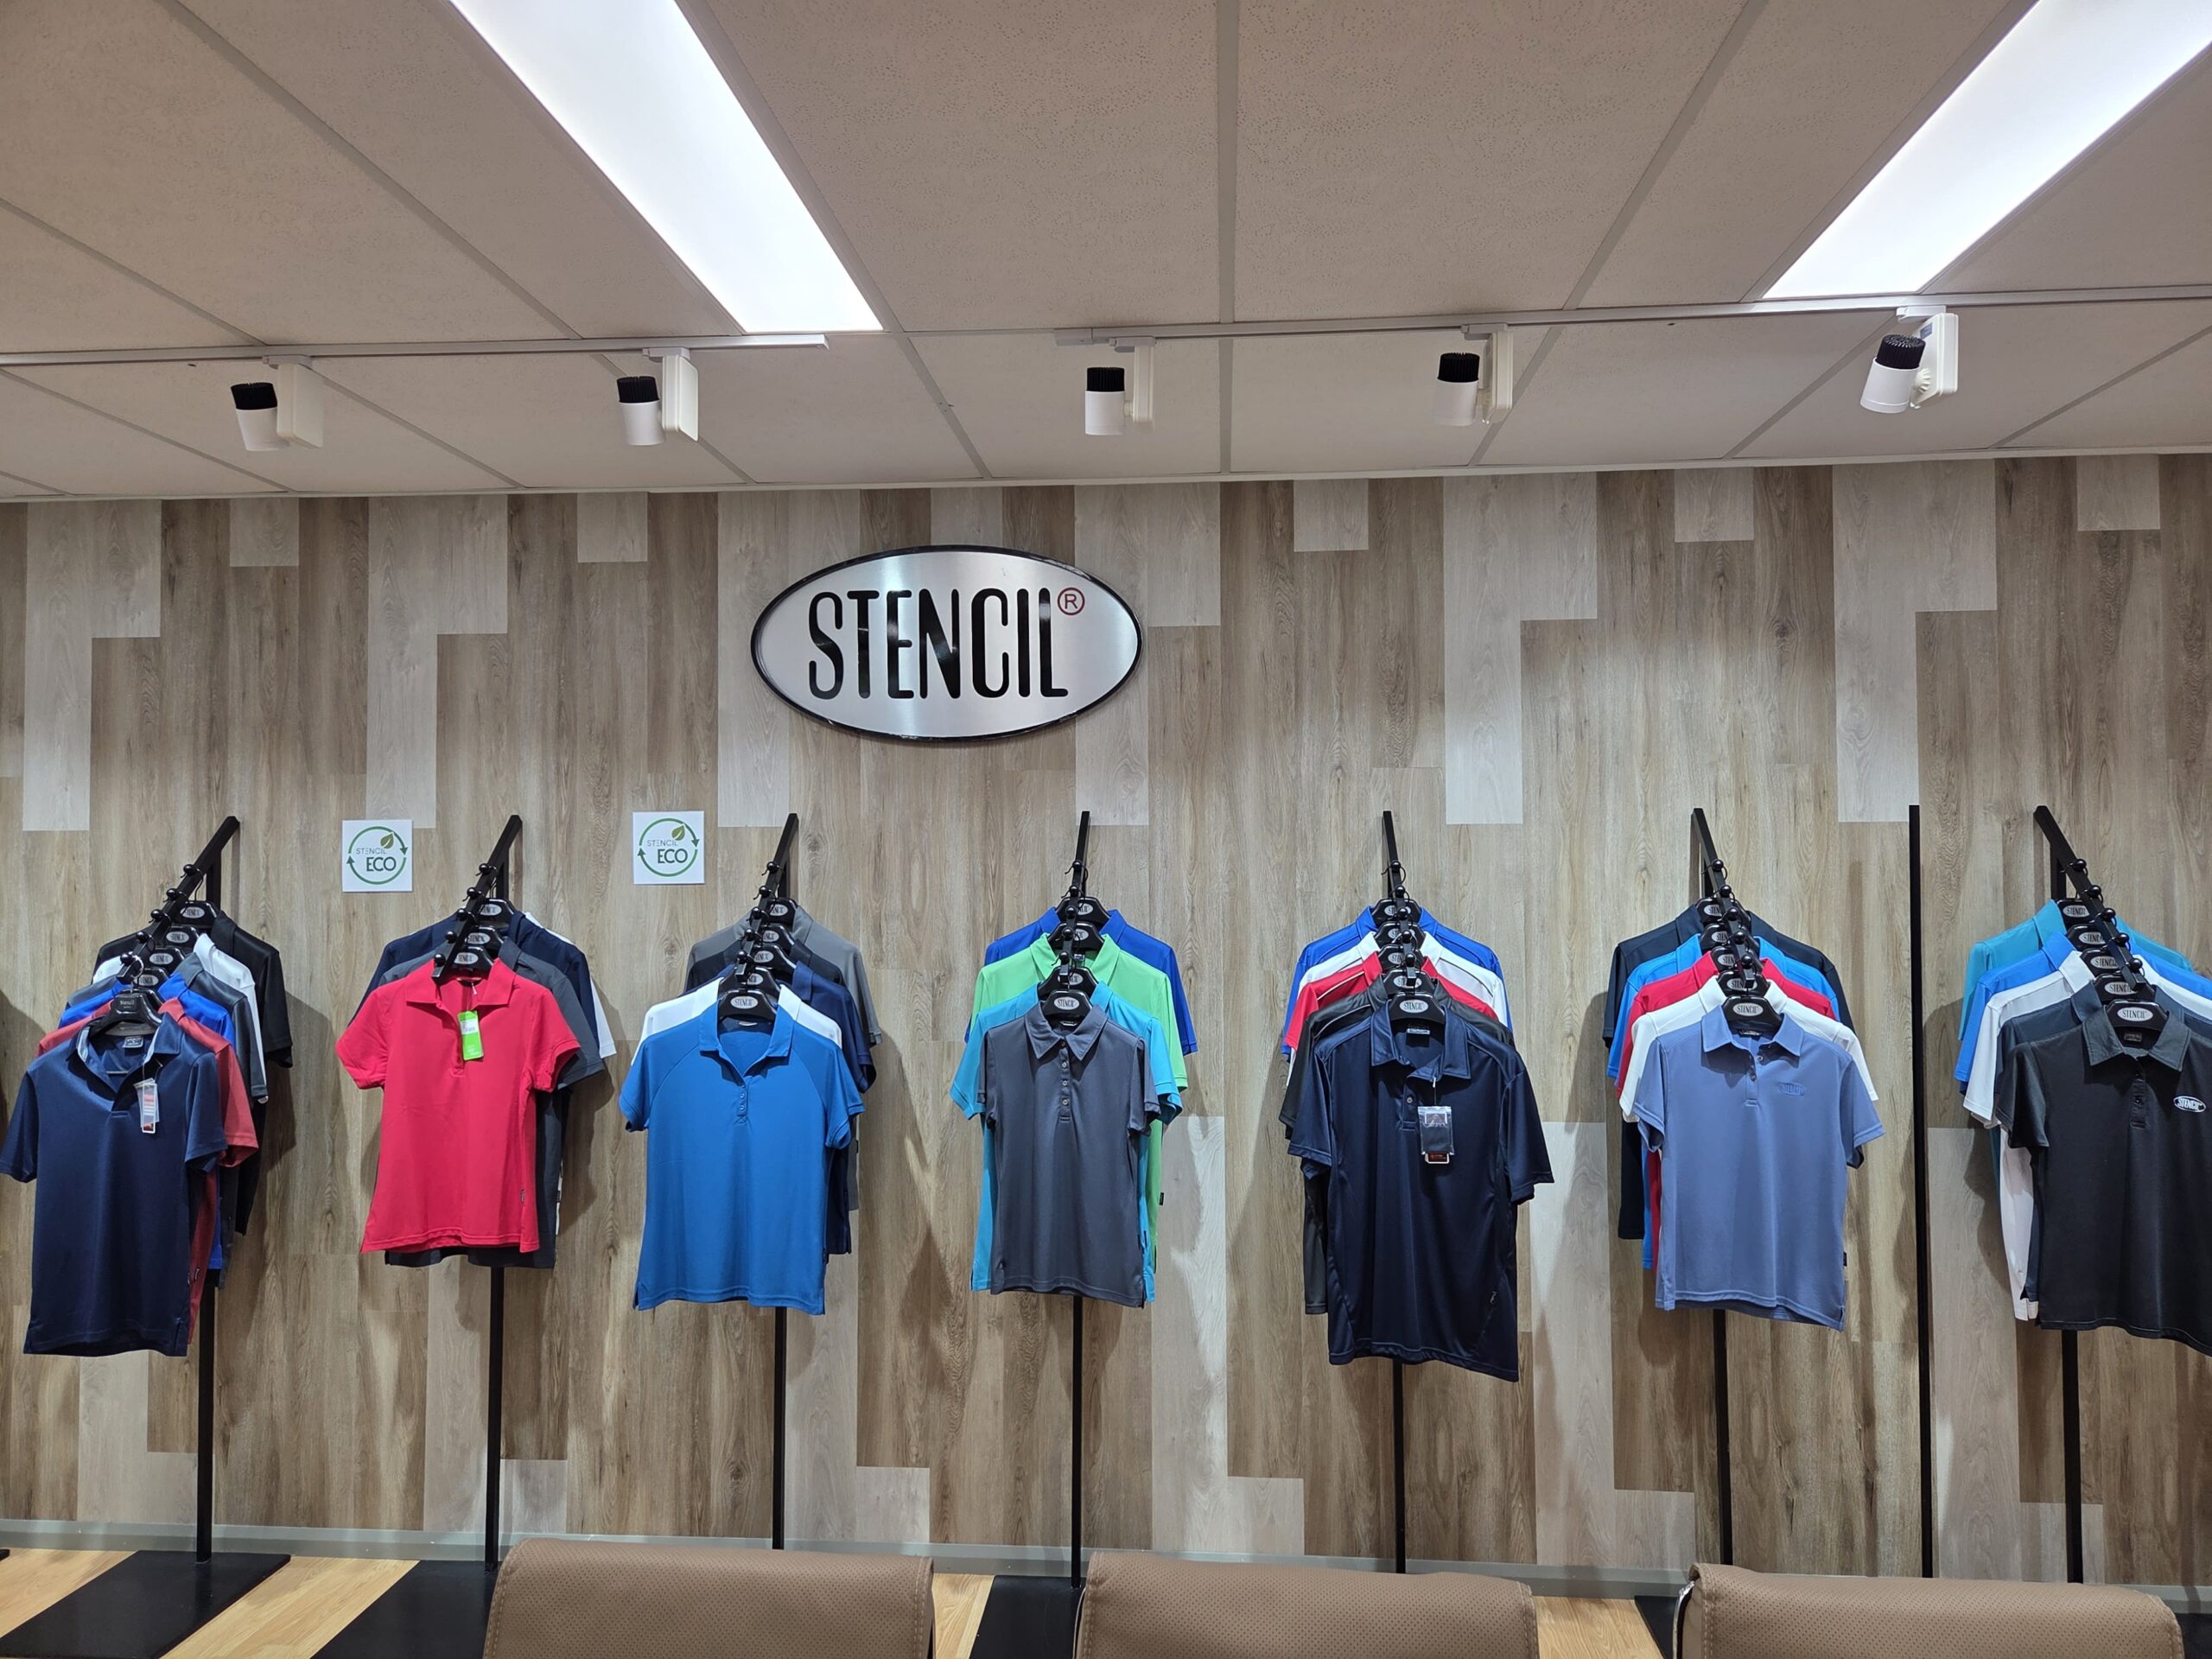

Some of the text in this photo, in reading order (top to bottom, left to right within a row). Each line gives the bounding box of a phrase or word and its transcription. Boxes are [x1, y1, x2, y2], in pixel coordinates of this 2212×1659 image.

[355, 847, 386, 855] STENCIL
[658, 849, 688, 864] ECO
[366, 856, 397, 872] ECO
